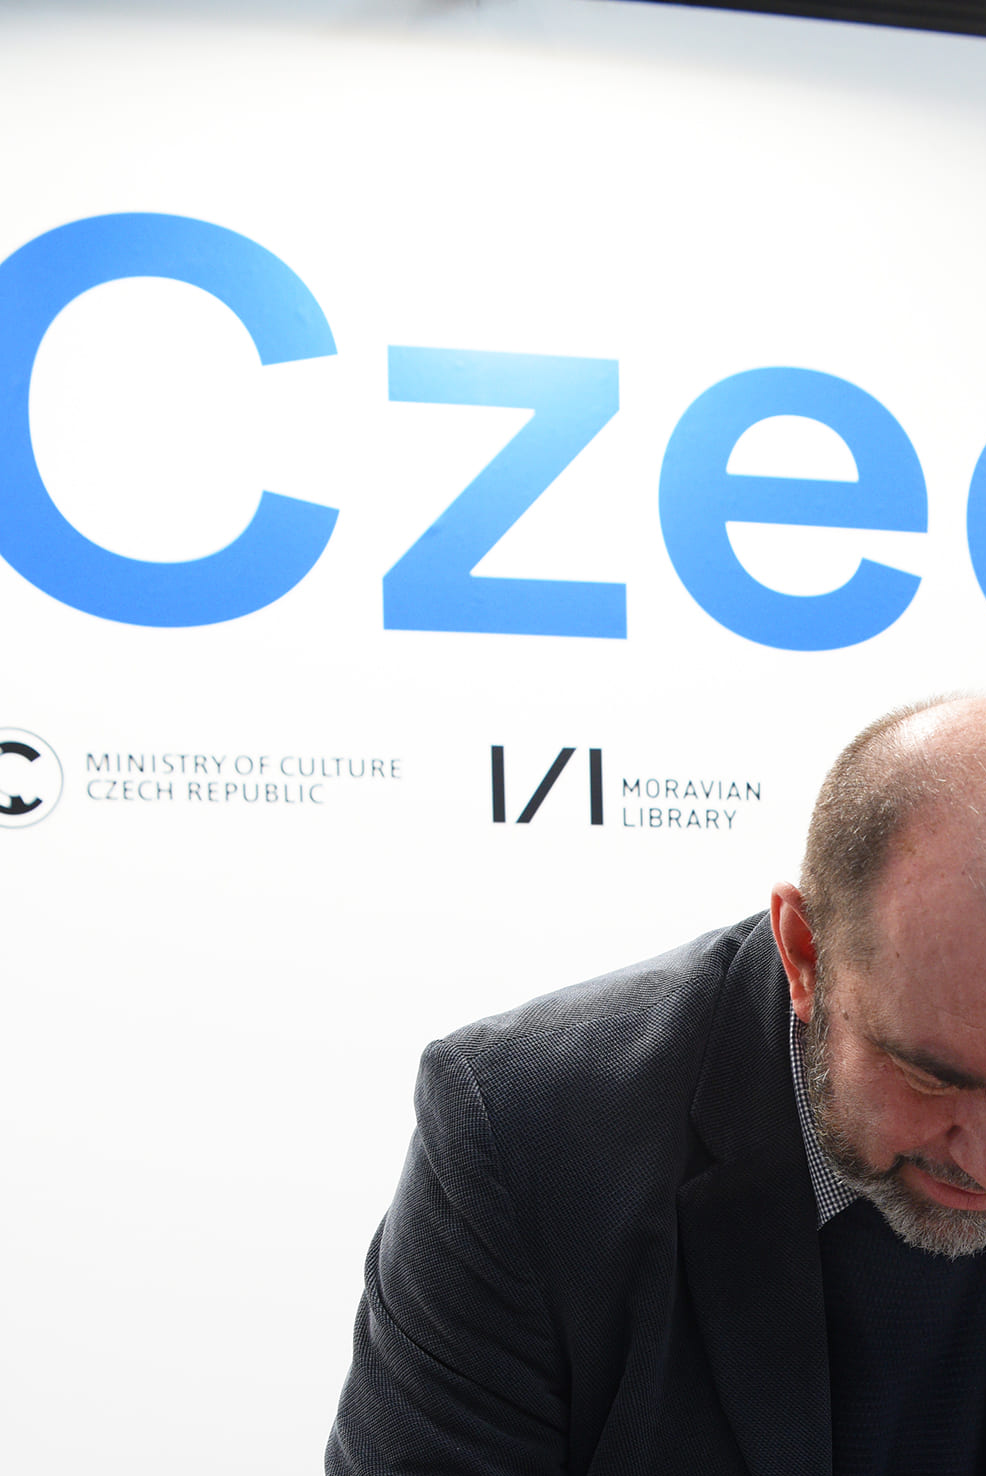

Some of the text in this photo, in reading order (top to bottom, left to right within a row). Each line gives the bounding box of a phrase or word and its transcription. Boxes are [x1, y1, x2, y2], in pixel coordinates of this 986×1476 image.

[86, 752, 403, 779] MINISTRY OF CULTURE
[86, 779, 326, 805] CZECH REPUBLIC
[622, 777, 762, 801] MORAVIAN
[622, 806, 737, 830] LIBRARY
